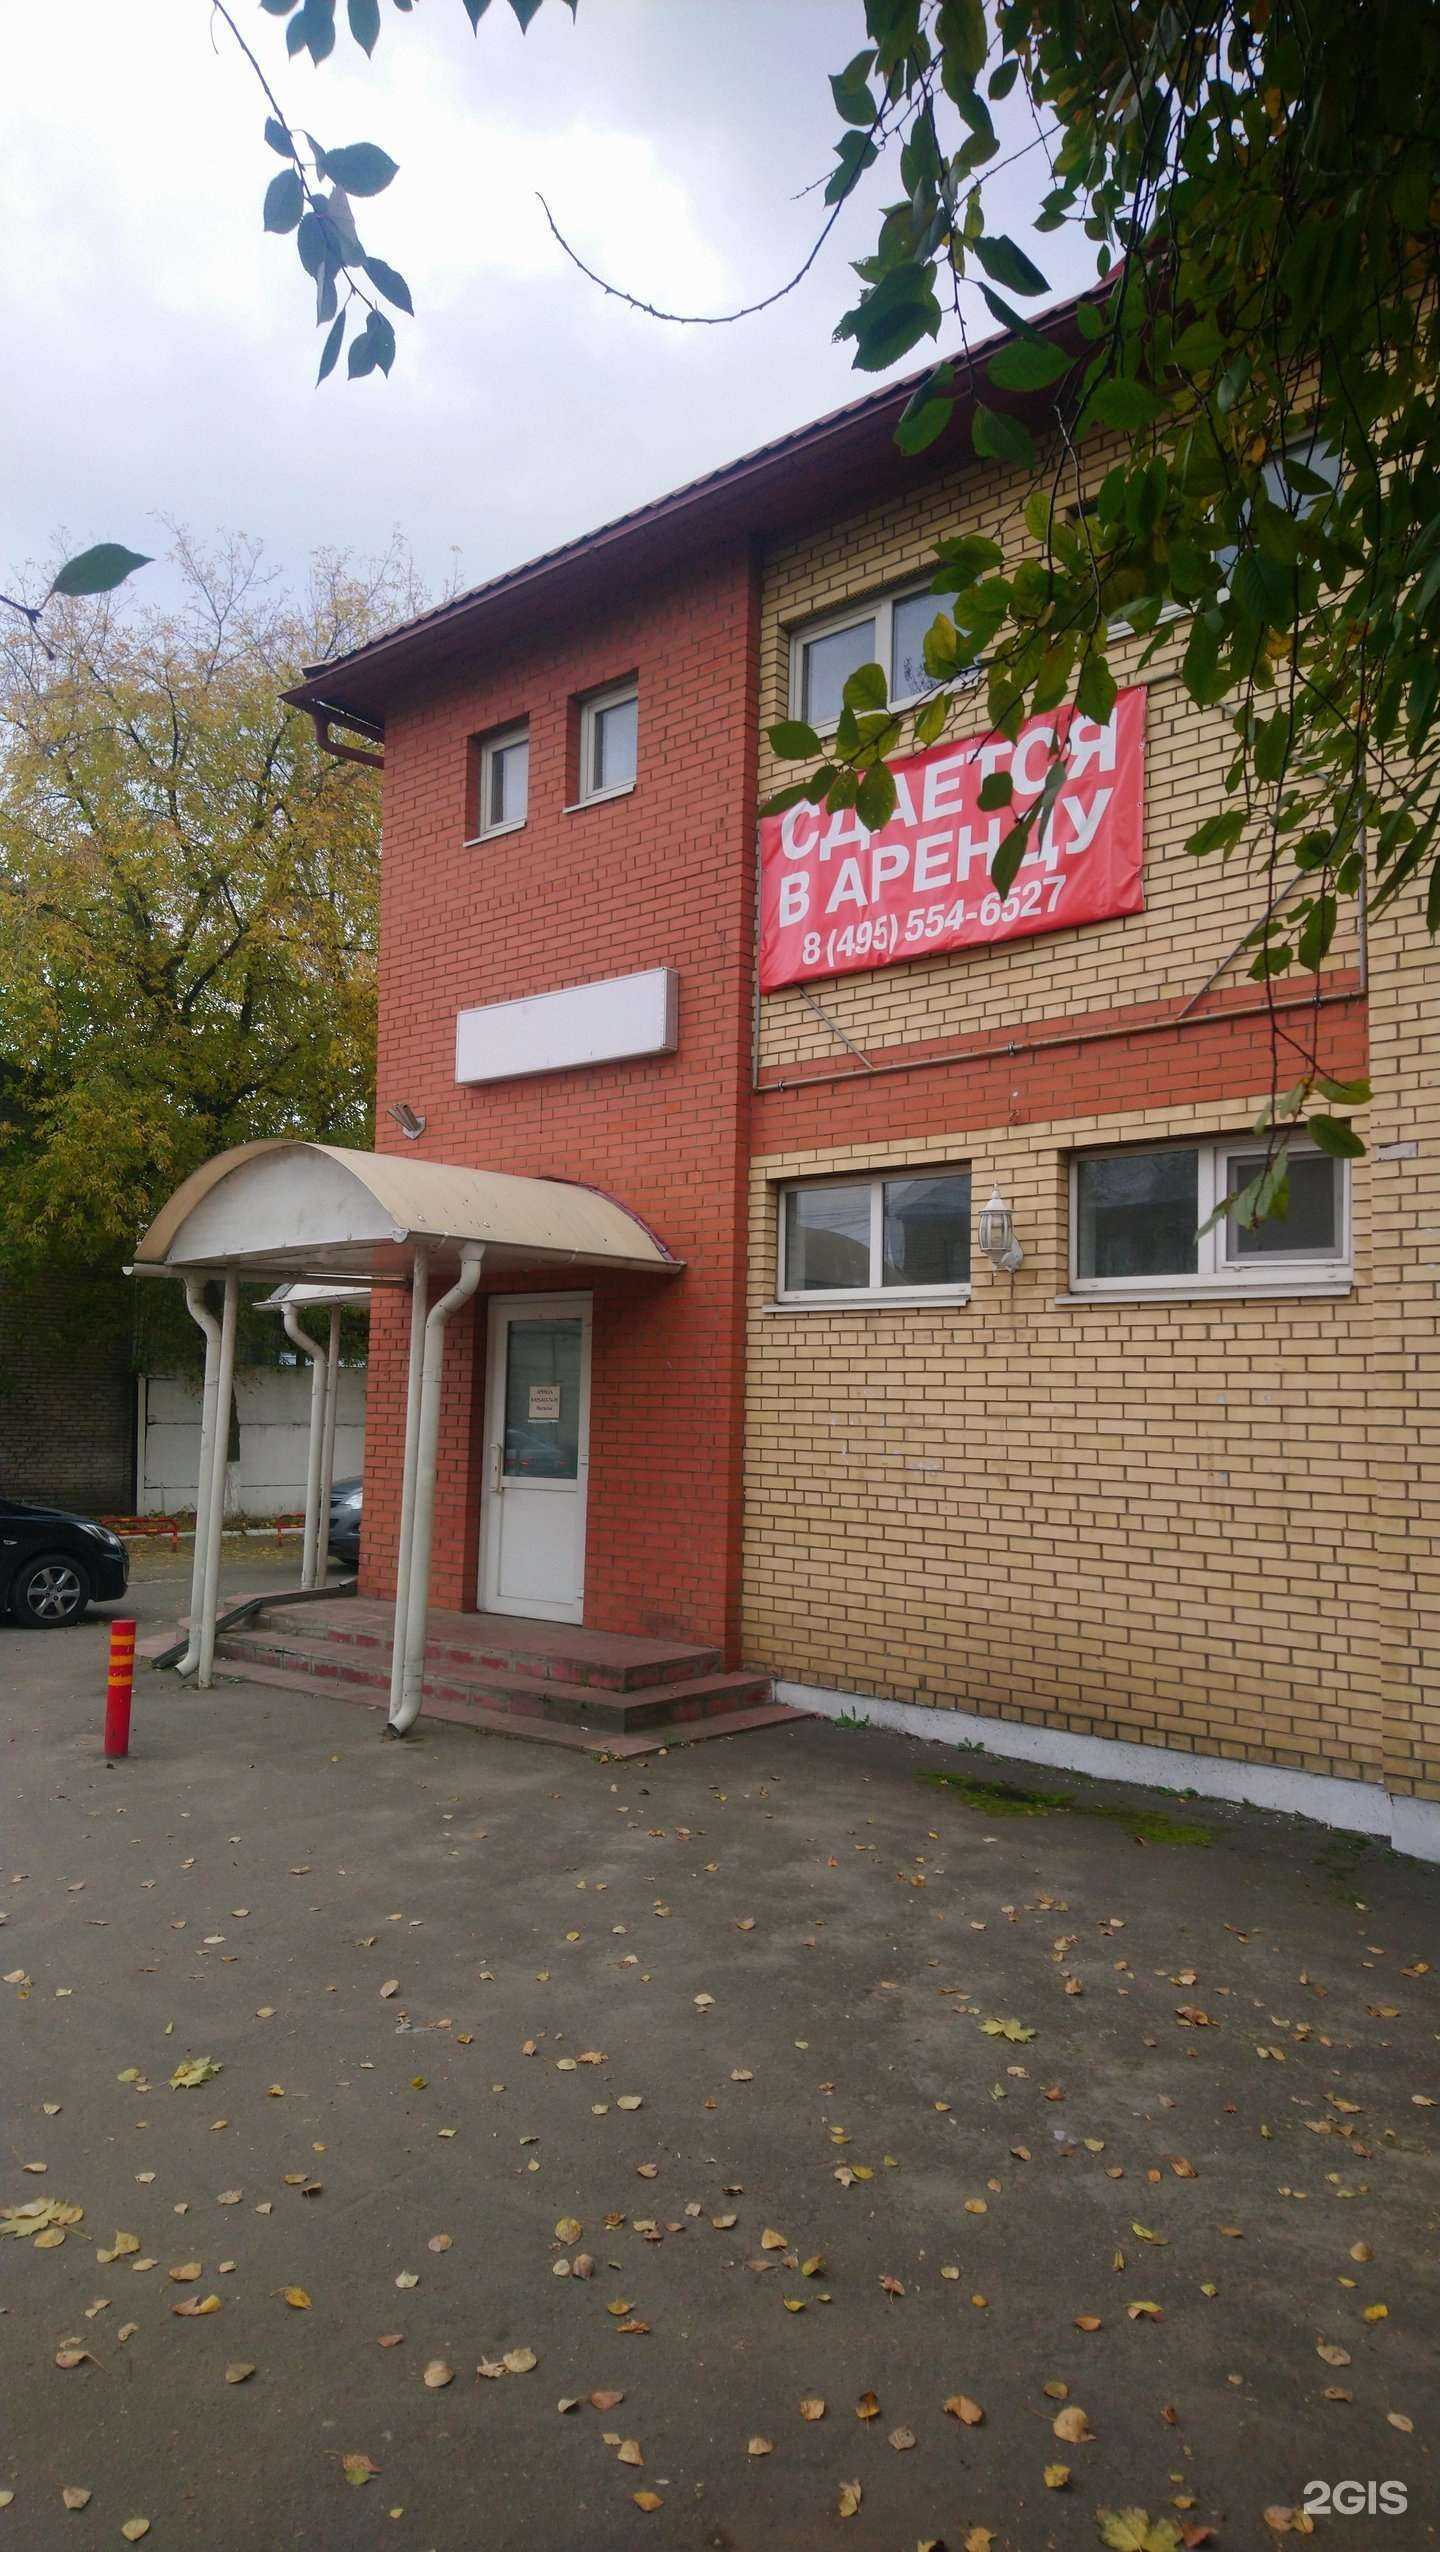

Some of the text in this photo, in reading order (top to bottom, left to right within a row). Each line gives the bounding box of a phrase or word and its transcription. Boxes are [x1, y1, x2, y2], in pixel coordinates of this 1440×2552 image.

[778, 870, 811, 928] В
[802, 875, 1067, 967] 8 (495) 554-6527
